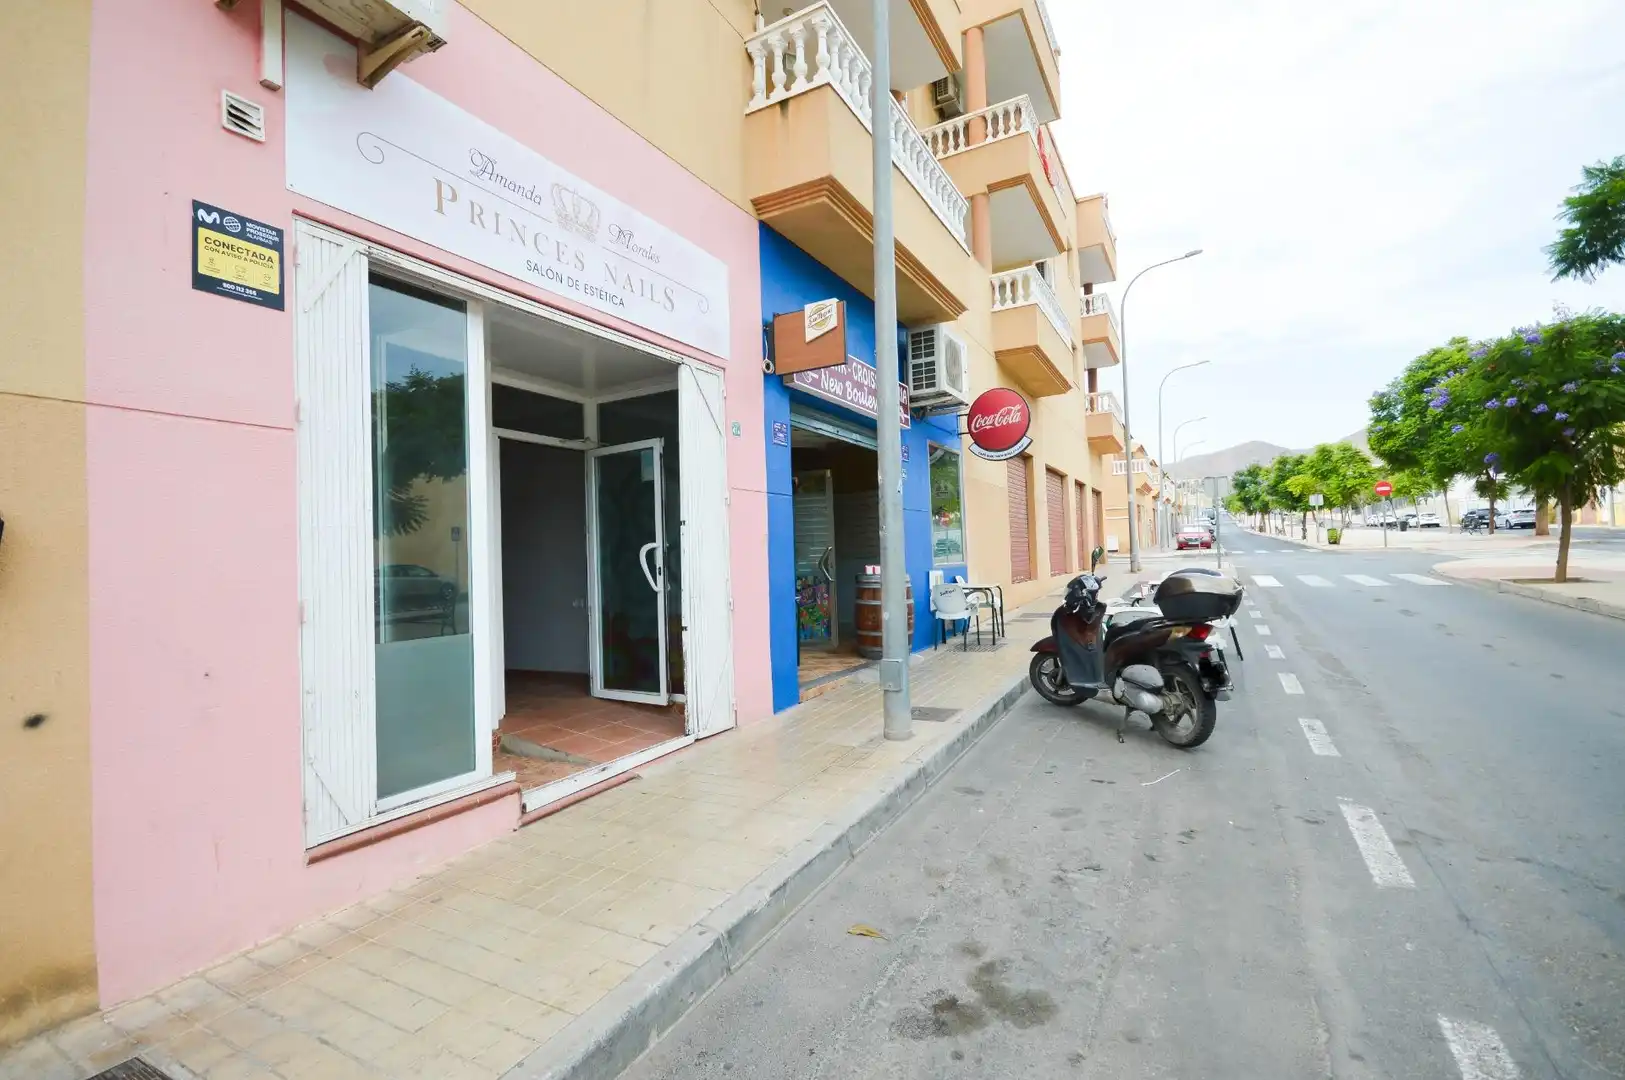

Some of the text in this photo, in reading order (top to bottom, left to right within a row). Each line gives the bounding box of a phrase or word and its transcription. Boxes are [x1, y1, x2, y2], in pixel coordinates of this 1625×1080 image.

[468, 147, 661, 264] Amanda Morales
[204, 236, 274, 264] CONECTADA
[204, 245, 220, 254] CON
[220, 250, 242, 260] AVISO
[432, 176, 675, 313] PRINCES NAILS
[526, 259, 625, 308] SALÓN DE ESTÉTICA
[821, 368, 878, 412] New Boulev
[971, 404, 1023, 433] Coca-Cola
